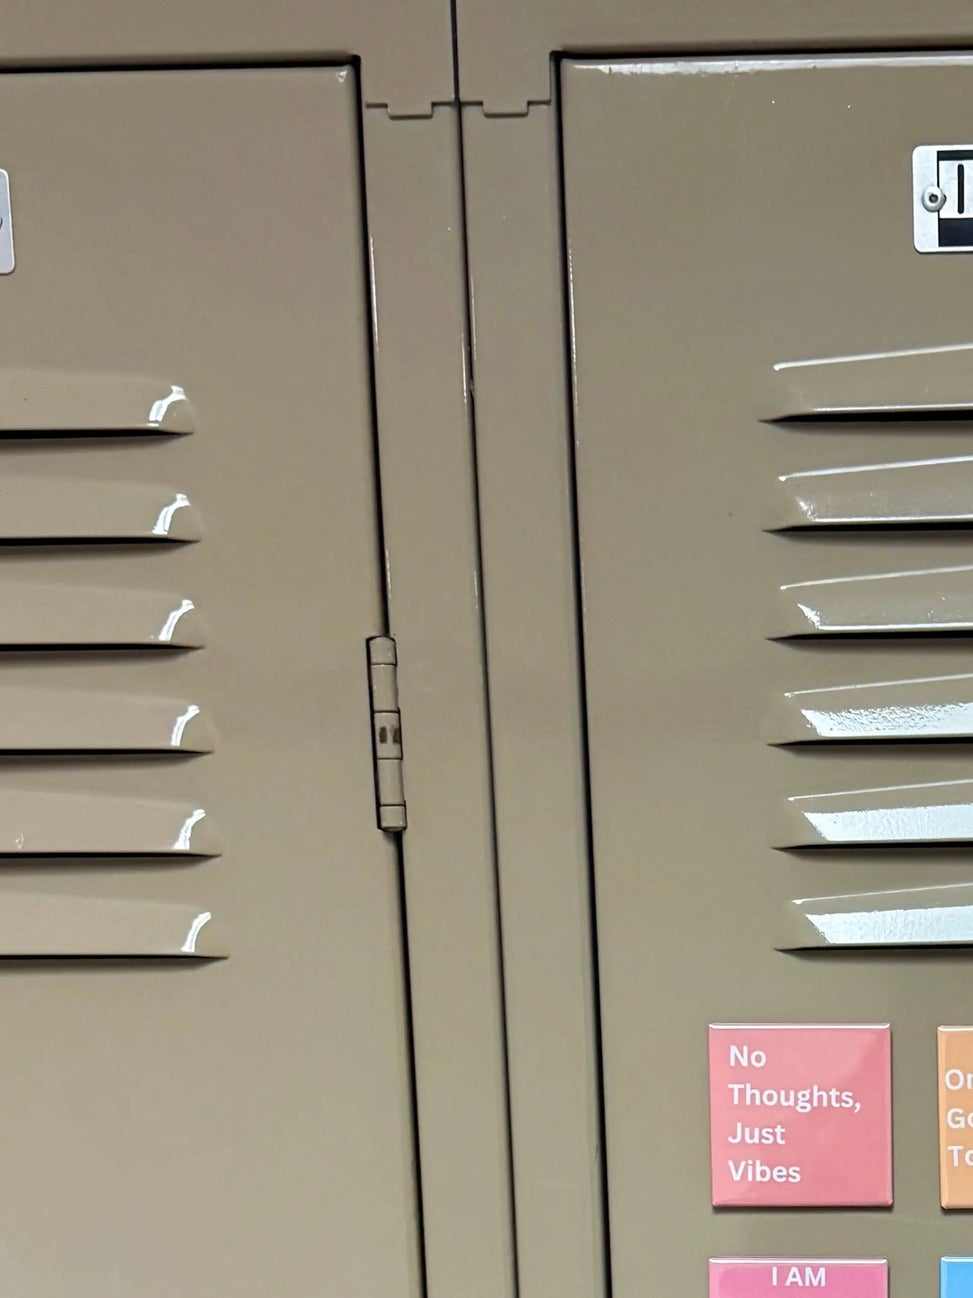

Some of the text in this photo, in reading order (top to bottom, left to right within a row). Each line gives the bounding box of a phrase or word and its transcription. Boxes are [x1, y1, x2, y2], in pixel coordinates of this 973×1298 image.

[730, 1045, 766, 1067] No
[728, 1083, 860, 1112] Thoughts,
[728, 1123, 785, 1144] Just
[728, 1160, 800, 1182] Vibes
[772, 1267, 825, 1286] I AM
